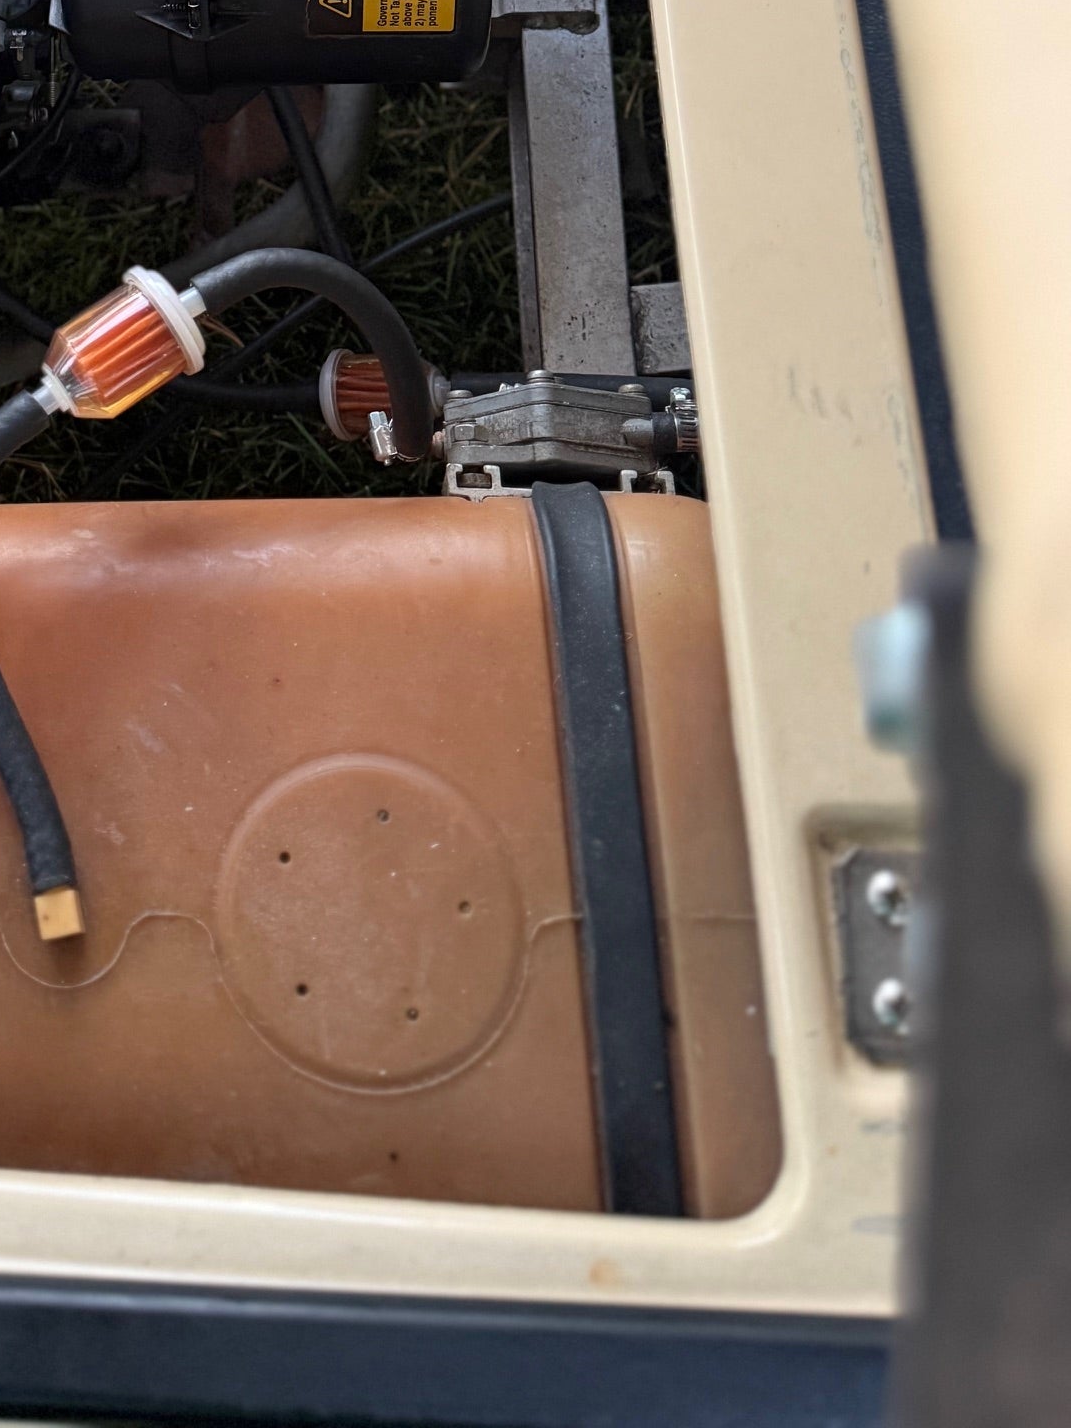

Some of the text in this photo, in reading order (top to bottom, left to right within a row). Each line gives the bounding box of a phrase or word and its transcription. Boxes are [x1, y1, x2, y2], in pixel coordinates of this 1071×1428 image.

[403, 3, 412, 26] above
[417, 0, 427, 16] may
[390, 12, 399, 26] Not
